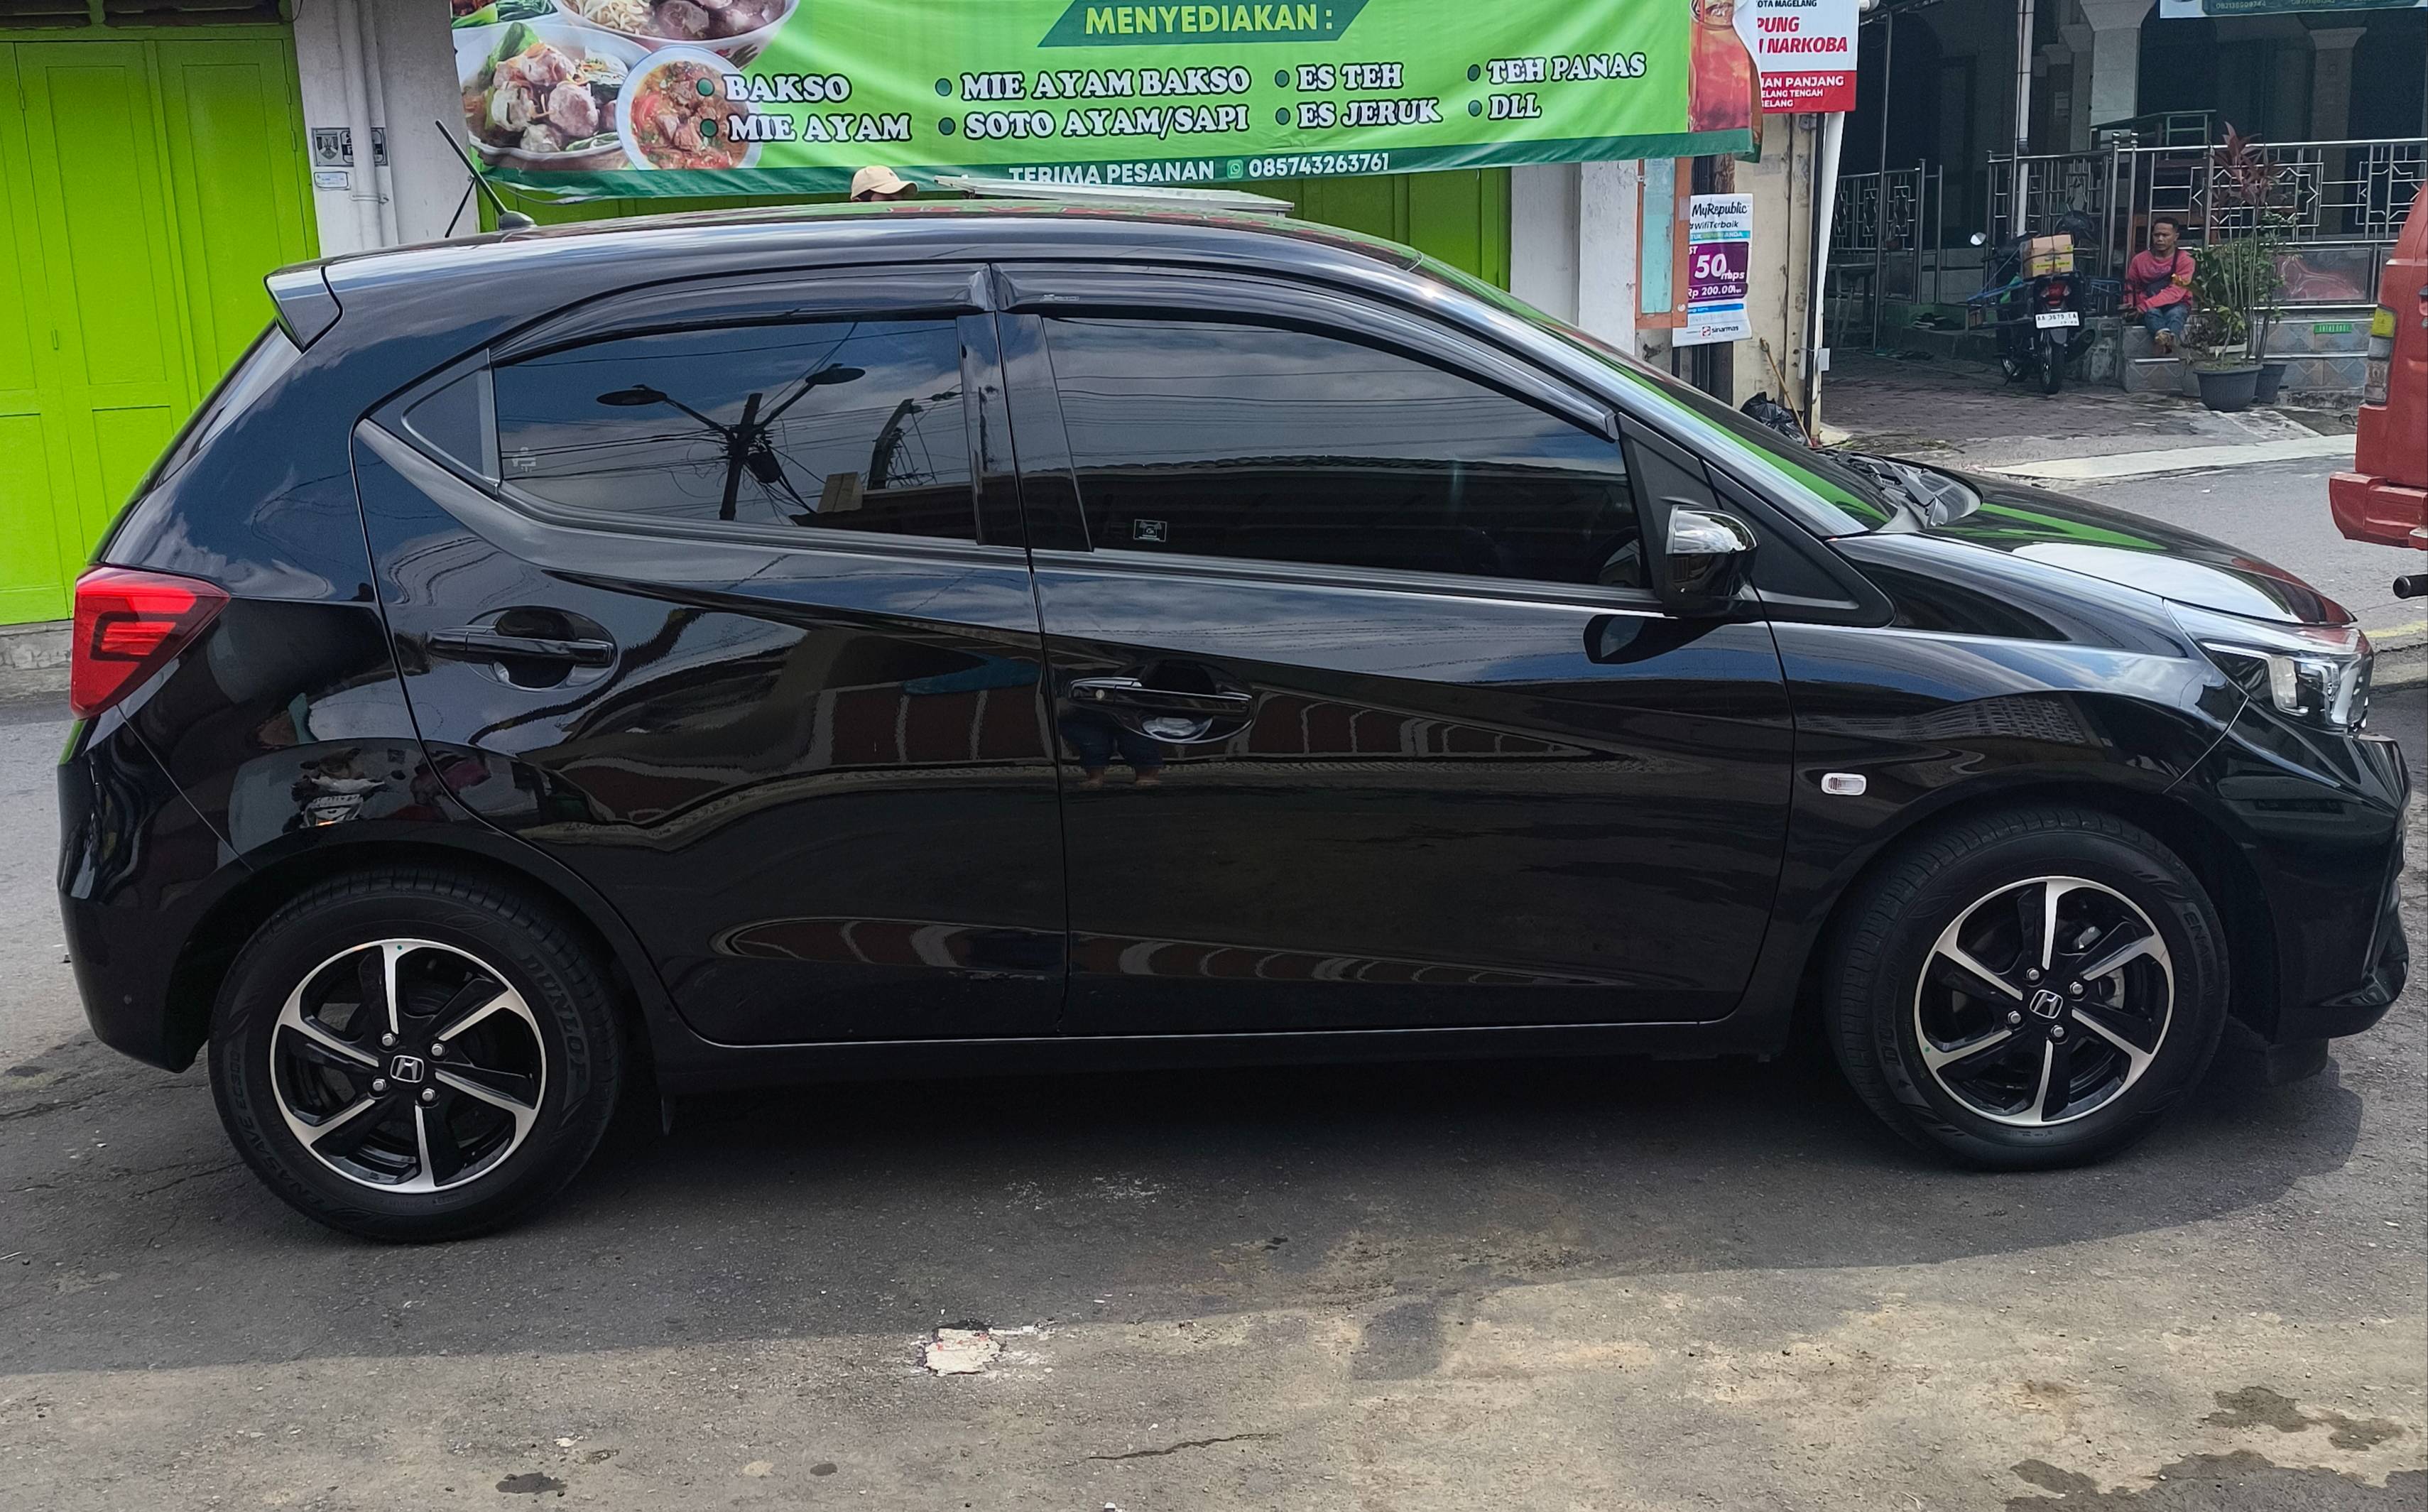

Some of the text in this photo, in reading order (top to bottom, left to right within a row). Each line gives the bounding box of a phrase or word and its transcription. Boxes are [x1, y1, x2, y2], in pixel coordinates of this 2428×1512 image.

[1084, 4, 1319, 35] MENYEDIAKAN
[1767, 37, 1848, 53] NARKOBA
[1296, 62, 1403, 92] ES TEH
[1486, 52, 1647, 85] TEH PANAS
[1785, 76, 1844, 87] PANJANG
[723, 73, 851, 103] BAKSO
[959, 66, 1252, 102] MIE AYAM BAKSO
[1790, 89, 1824, 97] TENGAH
[1297, 97, 1444, 130] ES JERUK
[1488, 92, 1542, 121] DLL
[728, 112, 913, 143] MIE AYAM
[963, 104, 1250, 141] SOTO AYAM/SAPI
[1008, 153, 1389, 185] TERIMA PESANAN 085743263761
[1692, 202, 1748, 219] MyRepublic
[1694, 254, 1727, 279] 50
[520, 954, 587, 1081] DUNLOP
